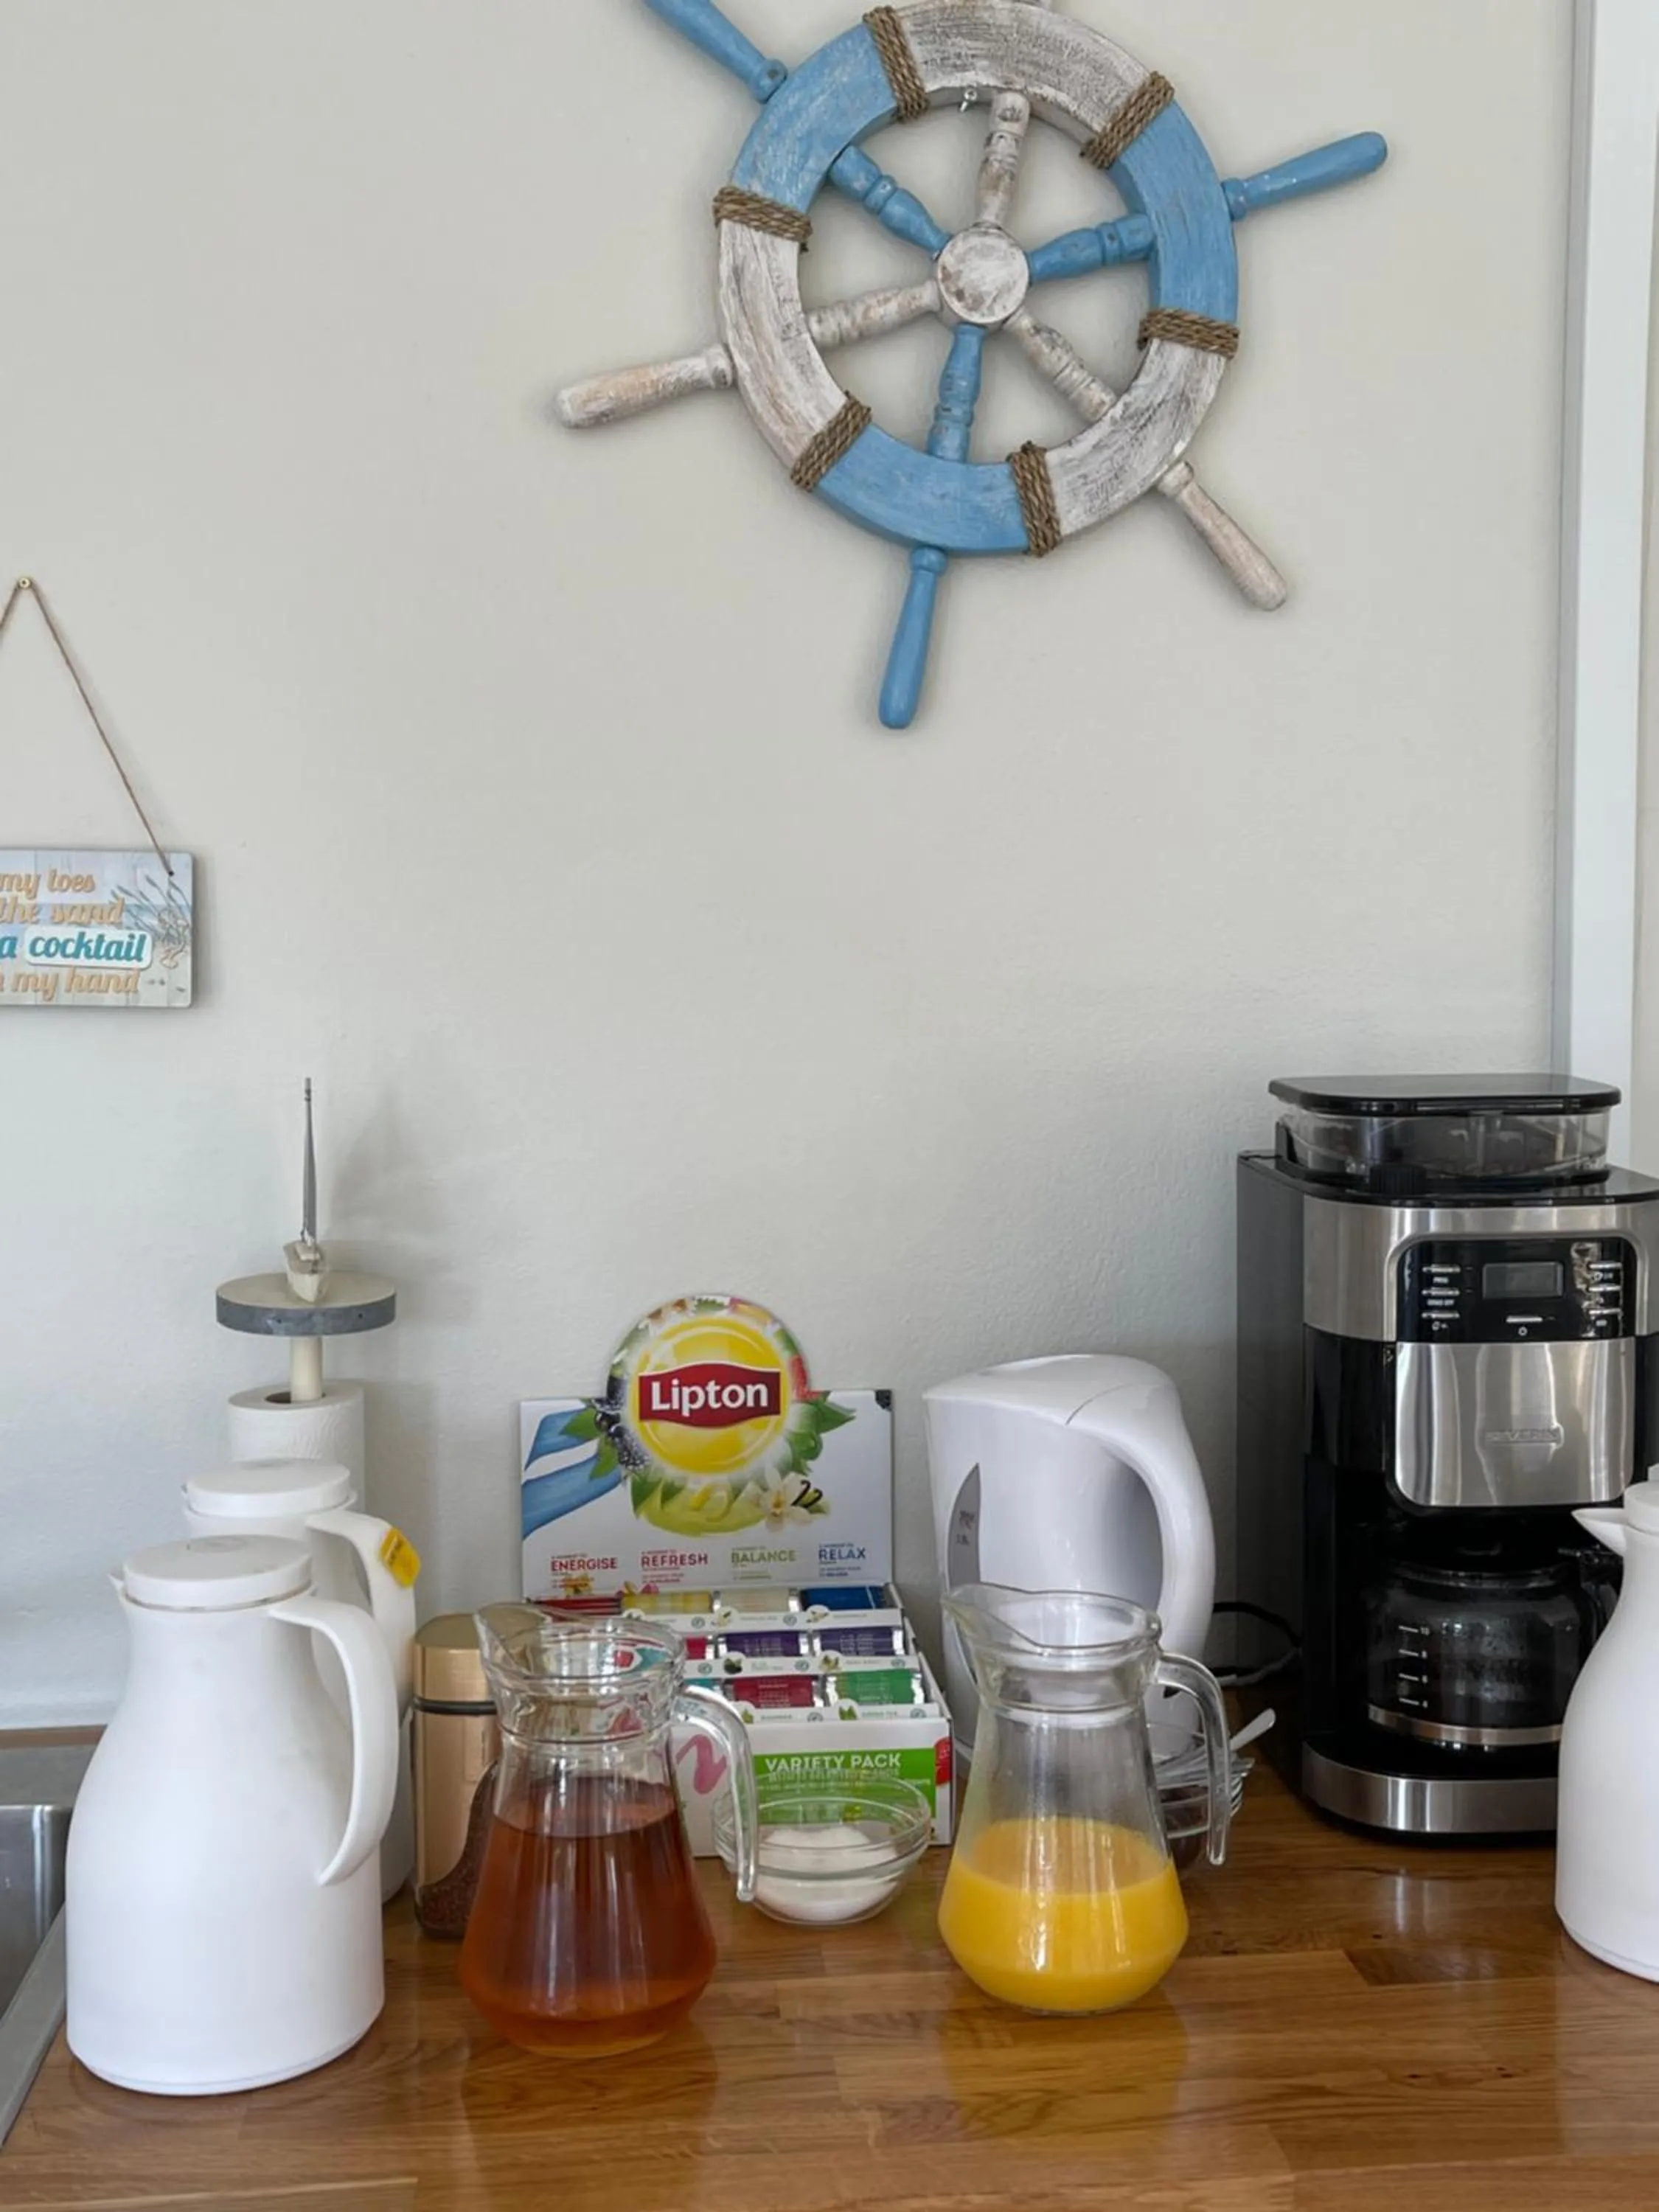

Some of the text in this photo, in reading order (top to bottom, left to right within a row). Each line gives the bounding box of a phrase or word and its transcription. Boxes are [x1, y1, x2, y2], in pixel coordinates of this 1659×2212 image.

[0, 869, 96, 900] my toes
[51, 897, 125, 925] sand
[0, 931, 147, 962] a cocktail
[11, 972, 59, 1001] my
[64, 966, 140, 994] hand
[650, 1378, 770, 1418] Lipton
[551, 1557, 618, 1572] ENERGISE
[641, 1553, 709, 1568] REFRESH
[731, 1550, 797, 1564] BALANCE
[818, 1547, 866, 1562] RELAX
[765, 1753, 902, 1773] VARIETY PACK
